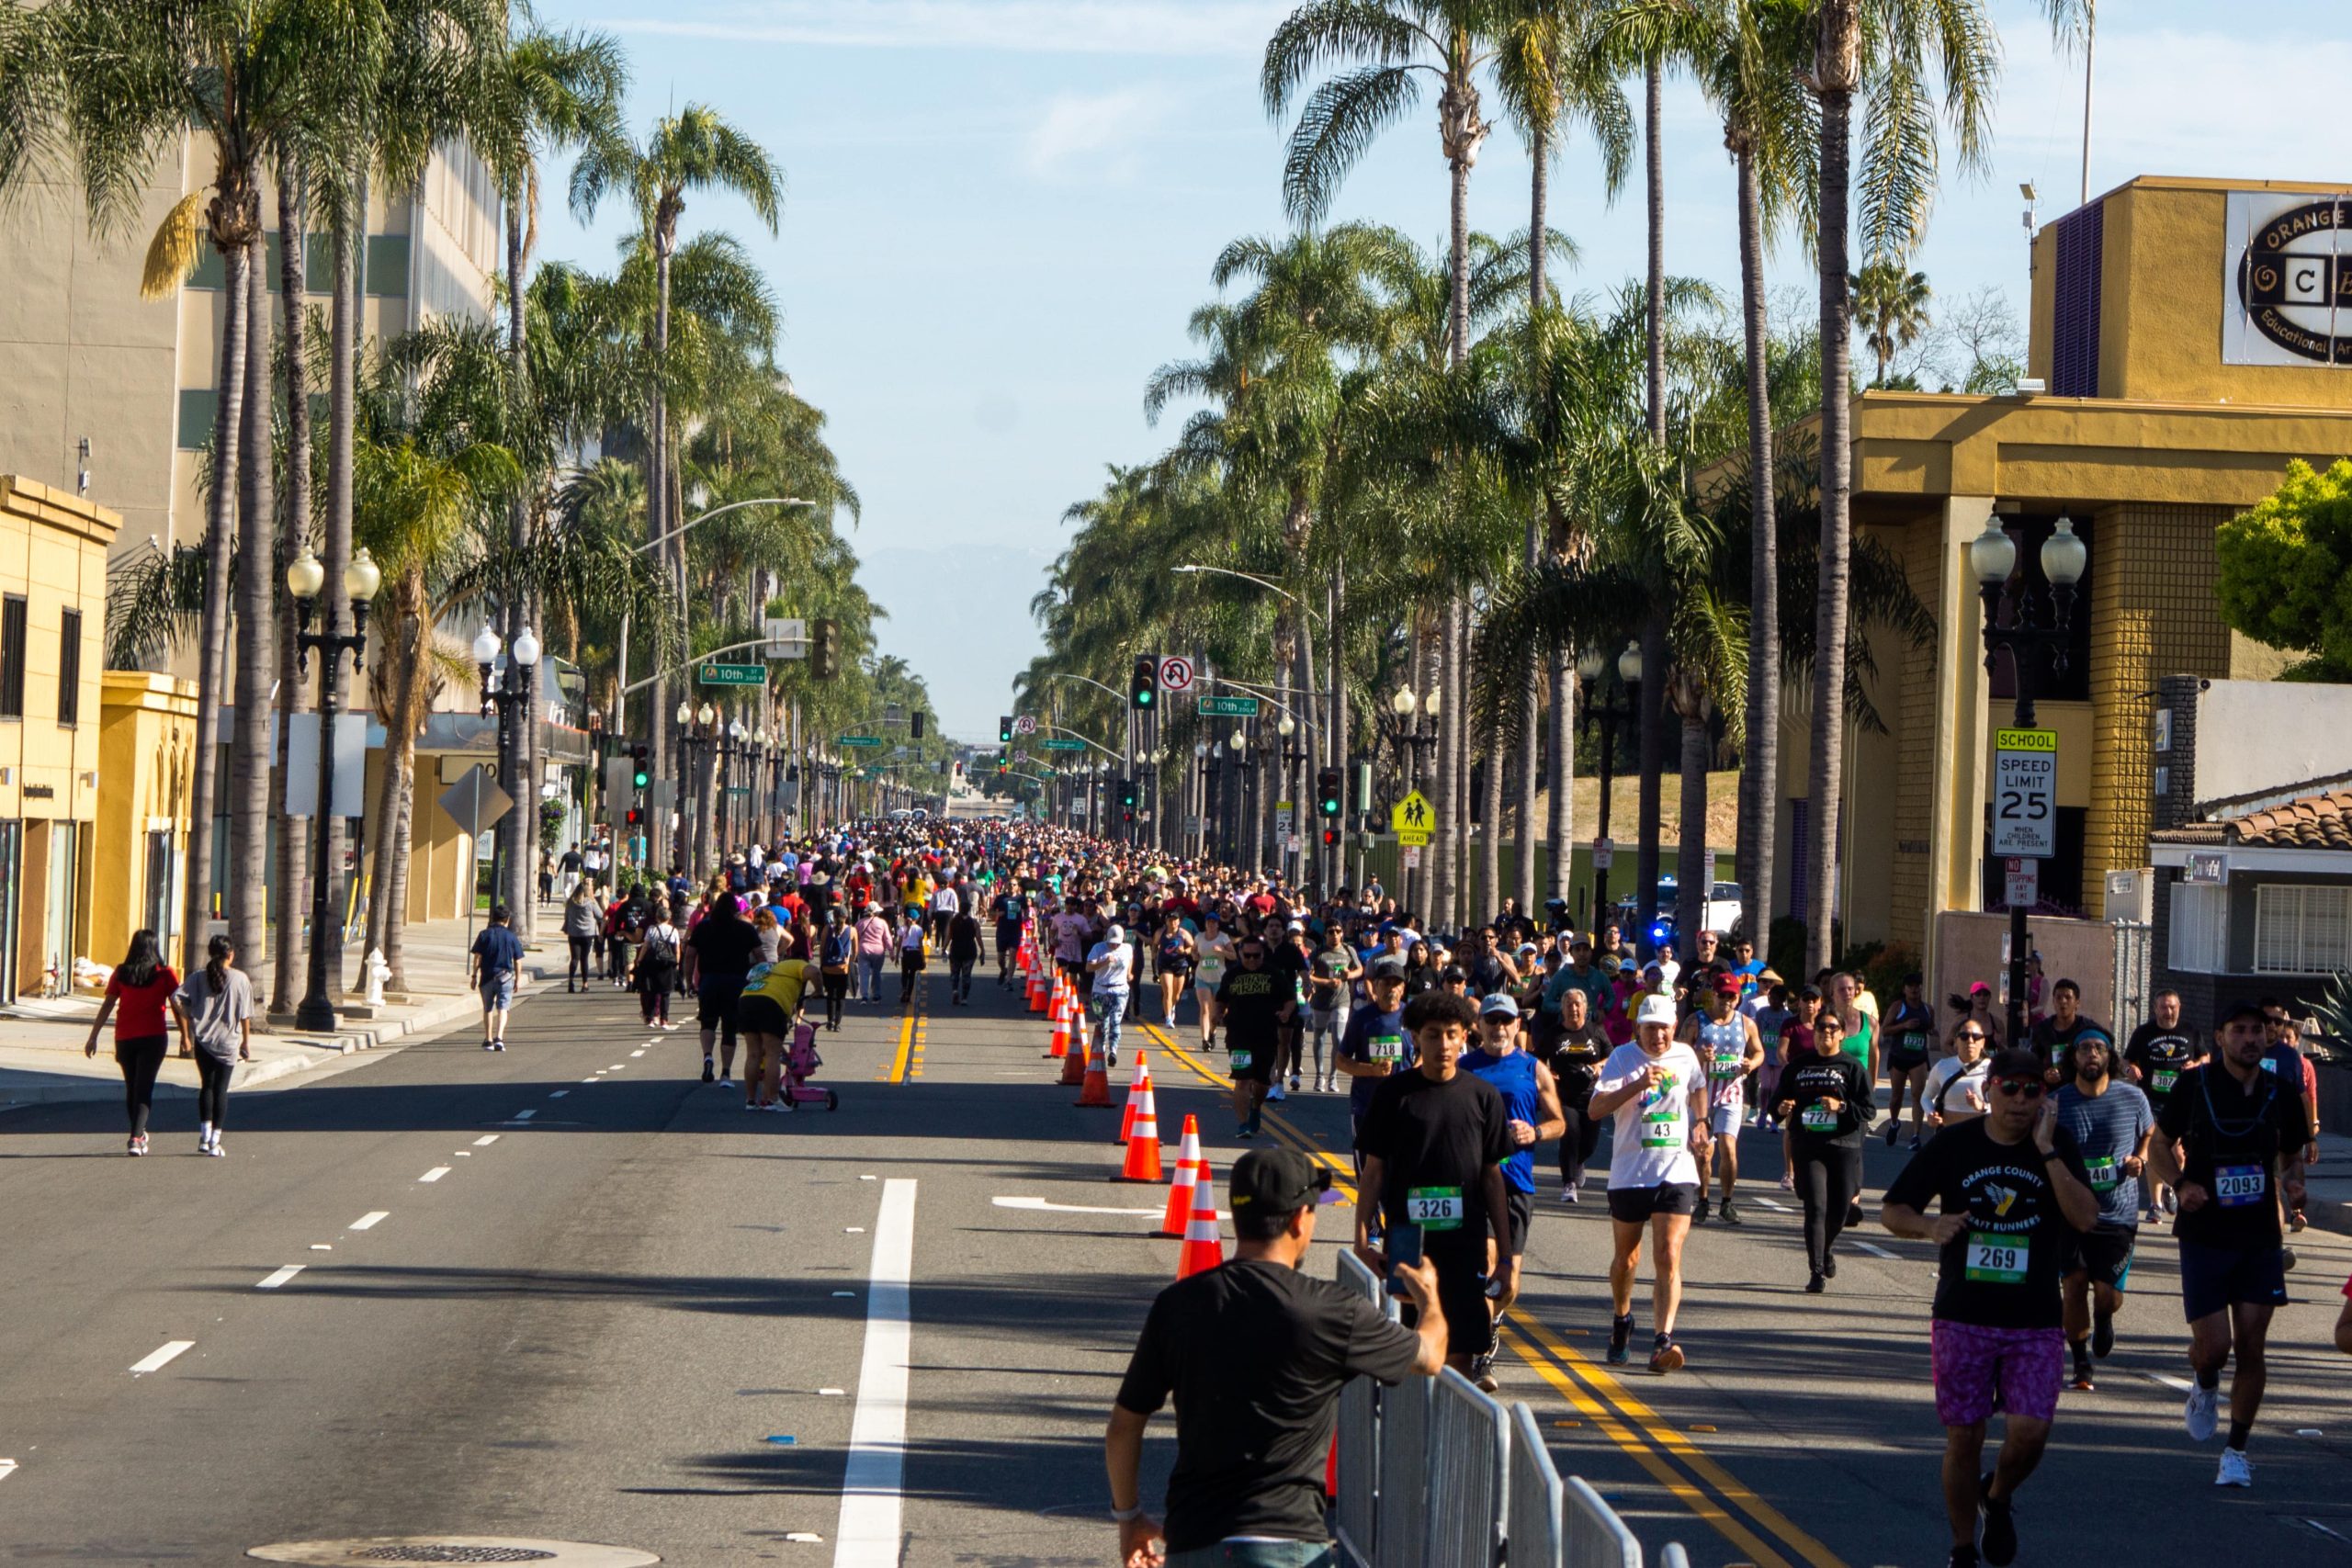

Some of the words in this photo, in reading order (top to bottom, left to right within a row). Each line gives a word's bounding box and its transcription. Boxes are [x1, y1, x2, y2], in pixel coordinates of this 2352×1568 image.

[2267, 209, 2346, 249] ORANGE
[2295, 270, 2315, 293] C
[2261, 308, 2327, 354] Educational
[720, 669, 743, 680] 10th
[1217, 702, 1238, 711] 10th
[1999, 733, 2053, 748] SCHOOL
[2000, 759, 2051, 773] SPEED
[2006, 775, 2045, 788] LIMIT
[2000, 791, 2048, 819] 25
[1402, 834, 1424, 842] AHEAD
[2017, 840, 2048, 848] PRESENT
[2008, 860, 2019, 871] NO
[2007, 874, 2036, 884] STOPPING
[2015, 892, 2028, 900] TIME
[1375, 1044, 1396, 1055] 718
[2157, 1076, 2174, 1086] 307
[1809, 1112, 1830, 1123] 727
[1654, 1123, 1670, 1137] 43
[1962, 1166, 2002, 1188] ORANGE
[2004, 1166, 2044, 1188] COUNTY
[2221, 1177, 2260, 1195] 2093
[1419, 1199, 1452, 1218] 326
[1993, 1214, 2041, 1232] RUNNERS
[1979, 1247, 2016, 1269] 269
